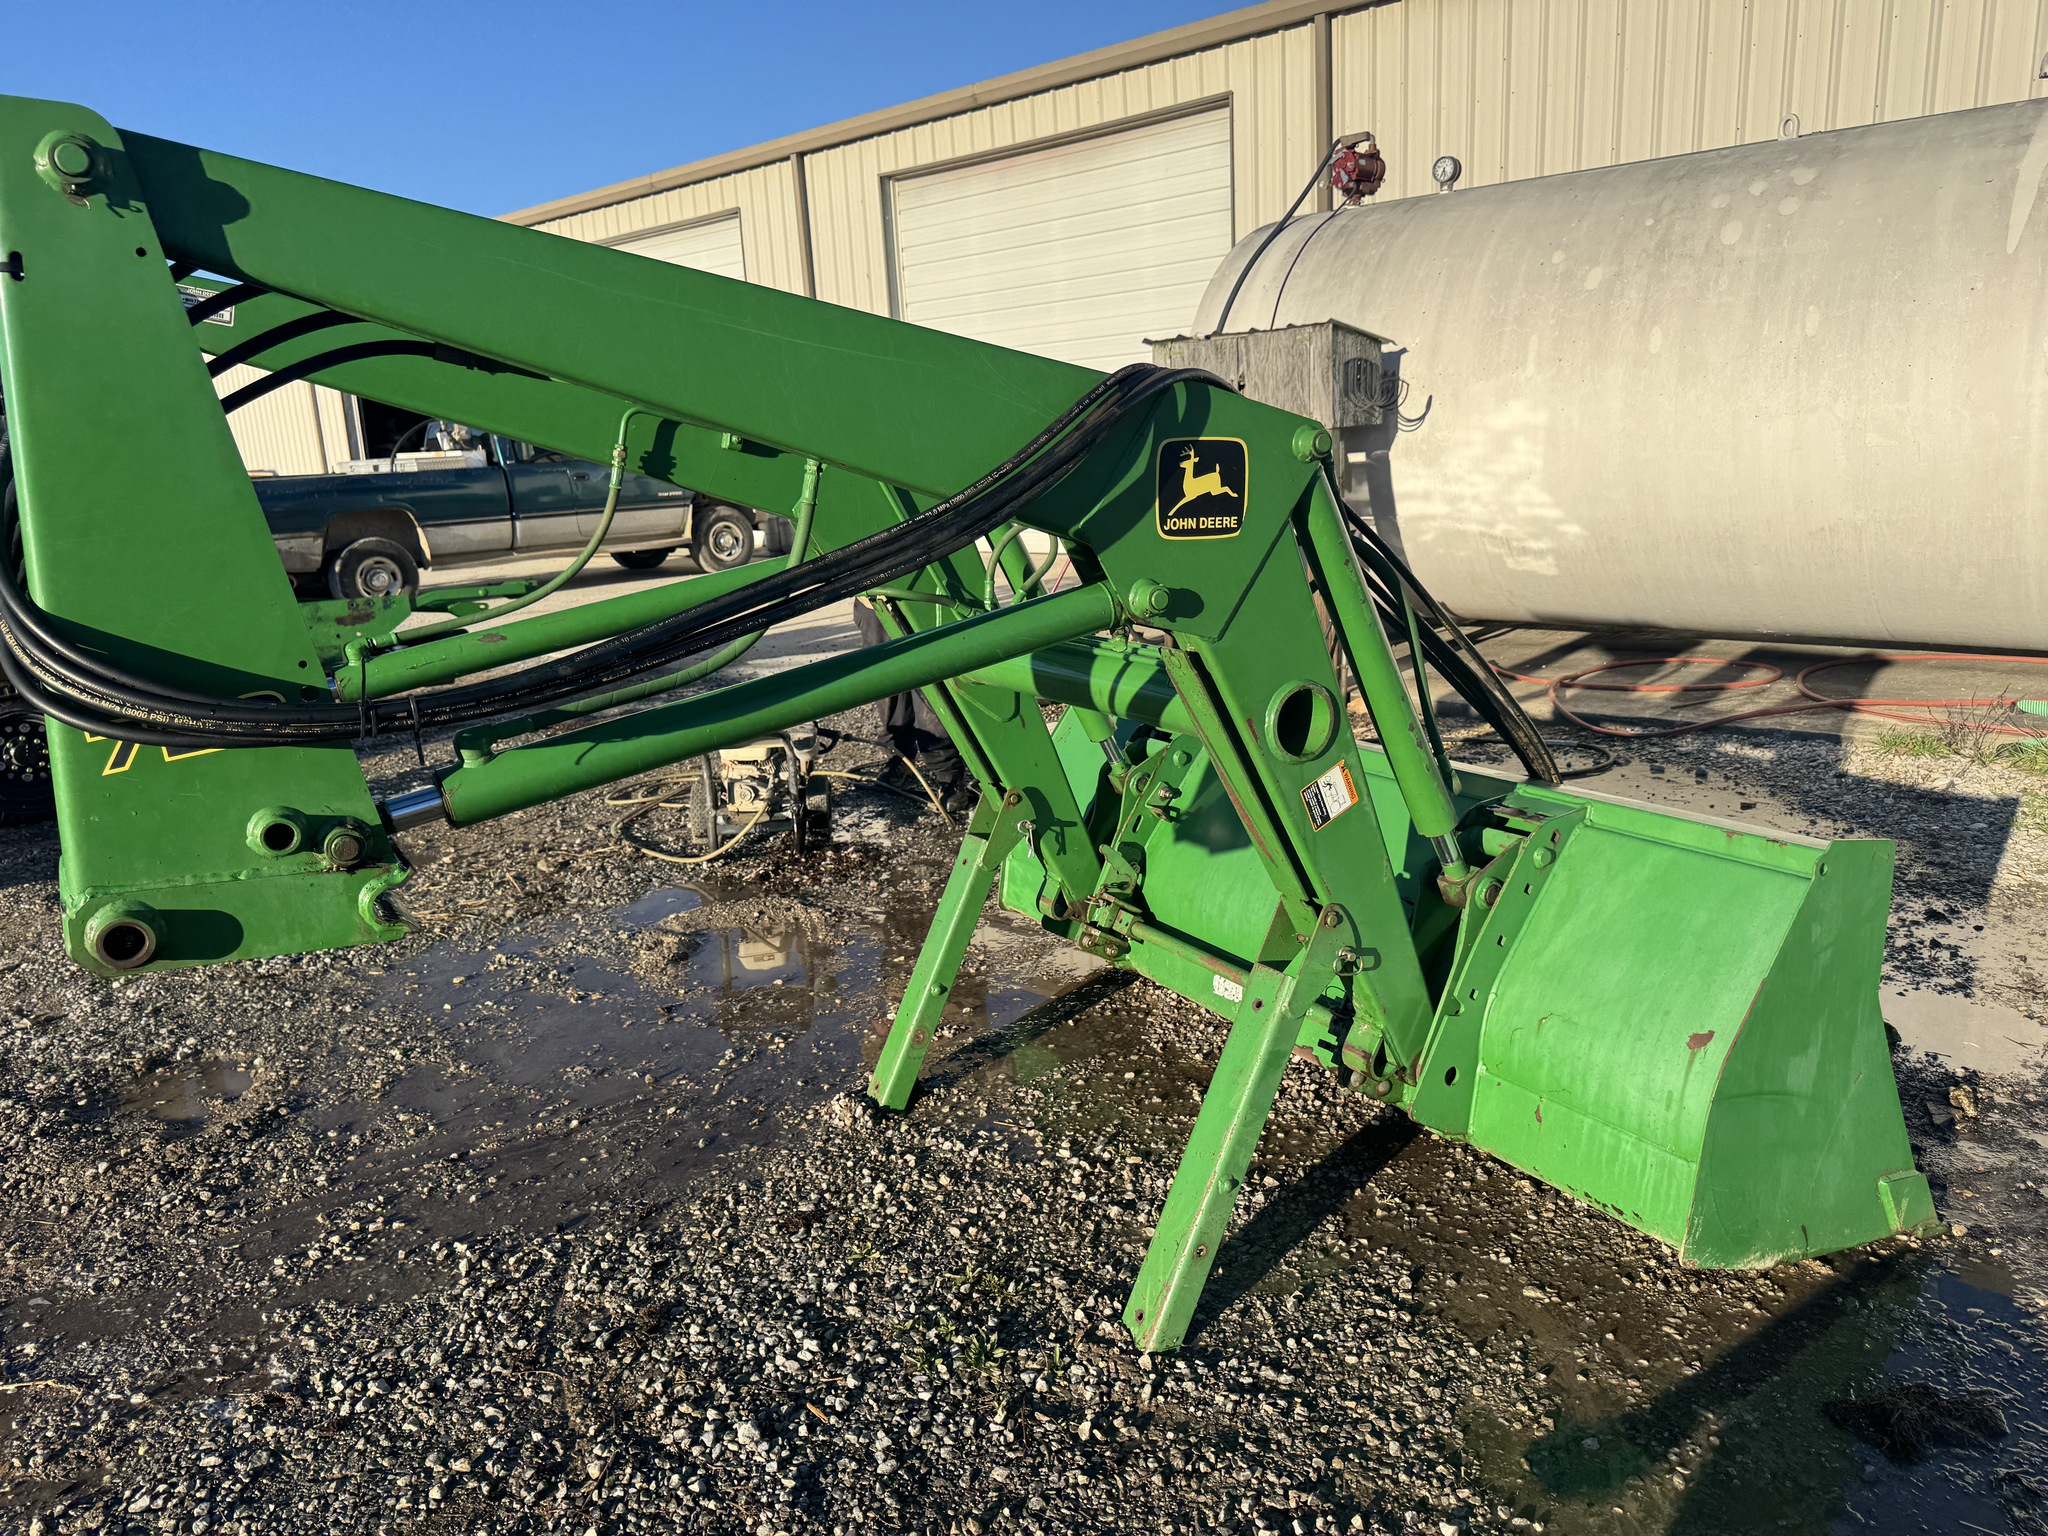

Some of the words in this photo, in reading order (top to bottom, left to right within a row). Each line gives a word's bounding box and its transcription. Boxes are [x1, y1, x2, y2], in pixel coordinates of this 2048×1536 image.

[1163, 517, 1197, 531] JOHN
[1199, 516, 1238, 529] DEERE
[101, 700, 120, 712] MPa
[122, 706, 148, 719] (3000
[149, 713, 170, 725] PSI)
[1343, 771, 1356, 800] WARNING
